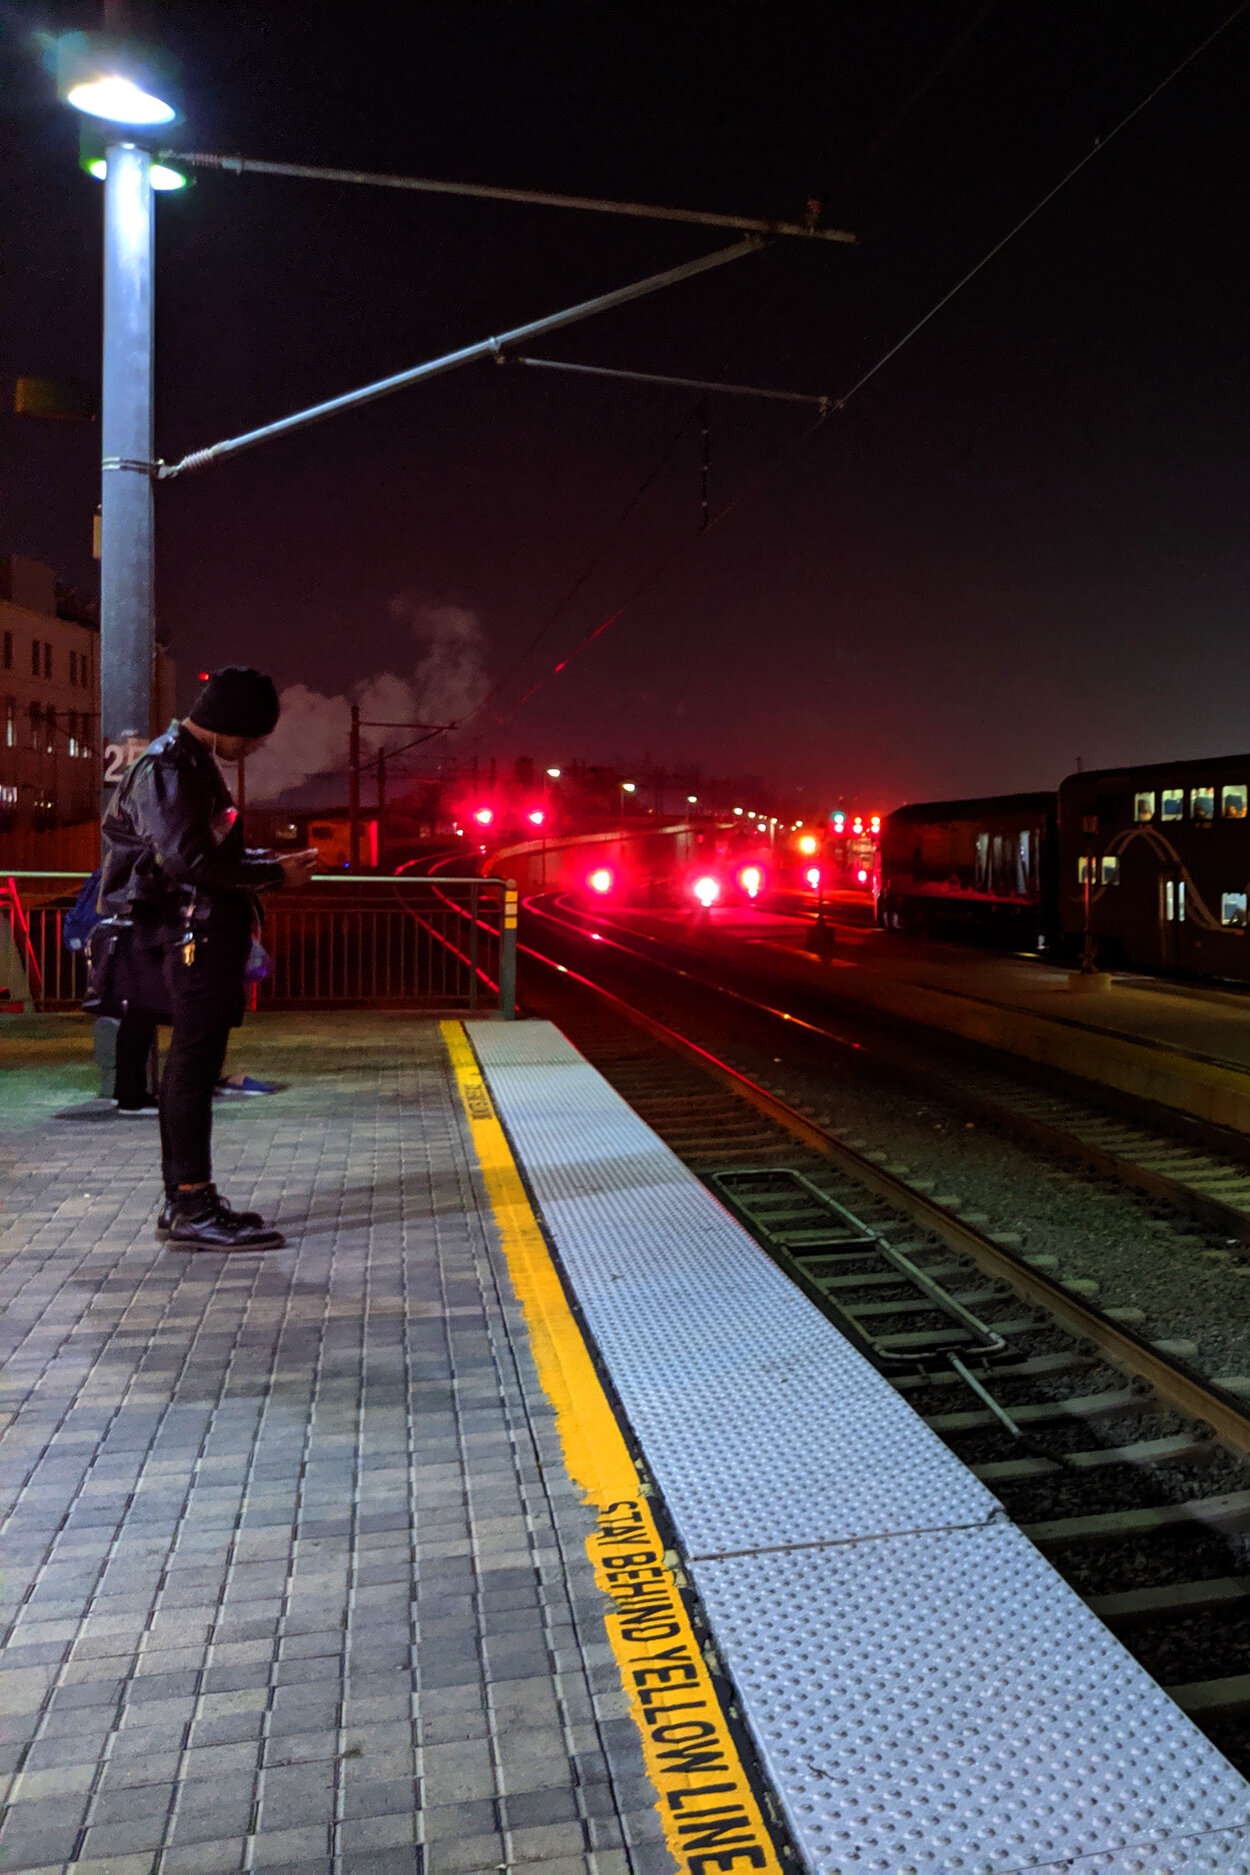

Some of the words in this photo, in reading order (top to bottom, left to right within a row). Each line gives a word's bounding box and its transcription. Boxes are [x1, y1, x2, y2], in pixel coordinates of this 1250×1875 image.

[597, 1500, 652, 1546] STAY
[601, 1550, 682, 1642] BEHIND
[629, 1644, 730, 1774] YELLOW
[666, 1783, 768, 1875] LINE
